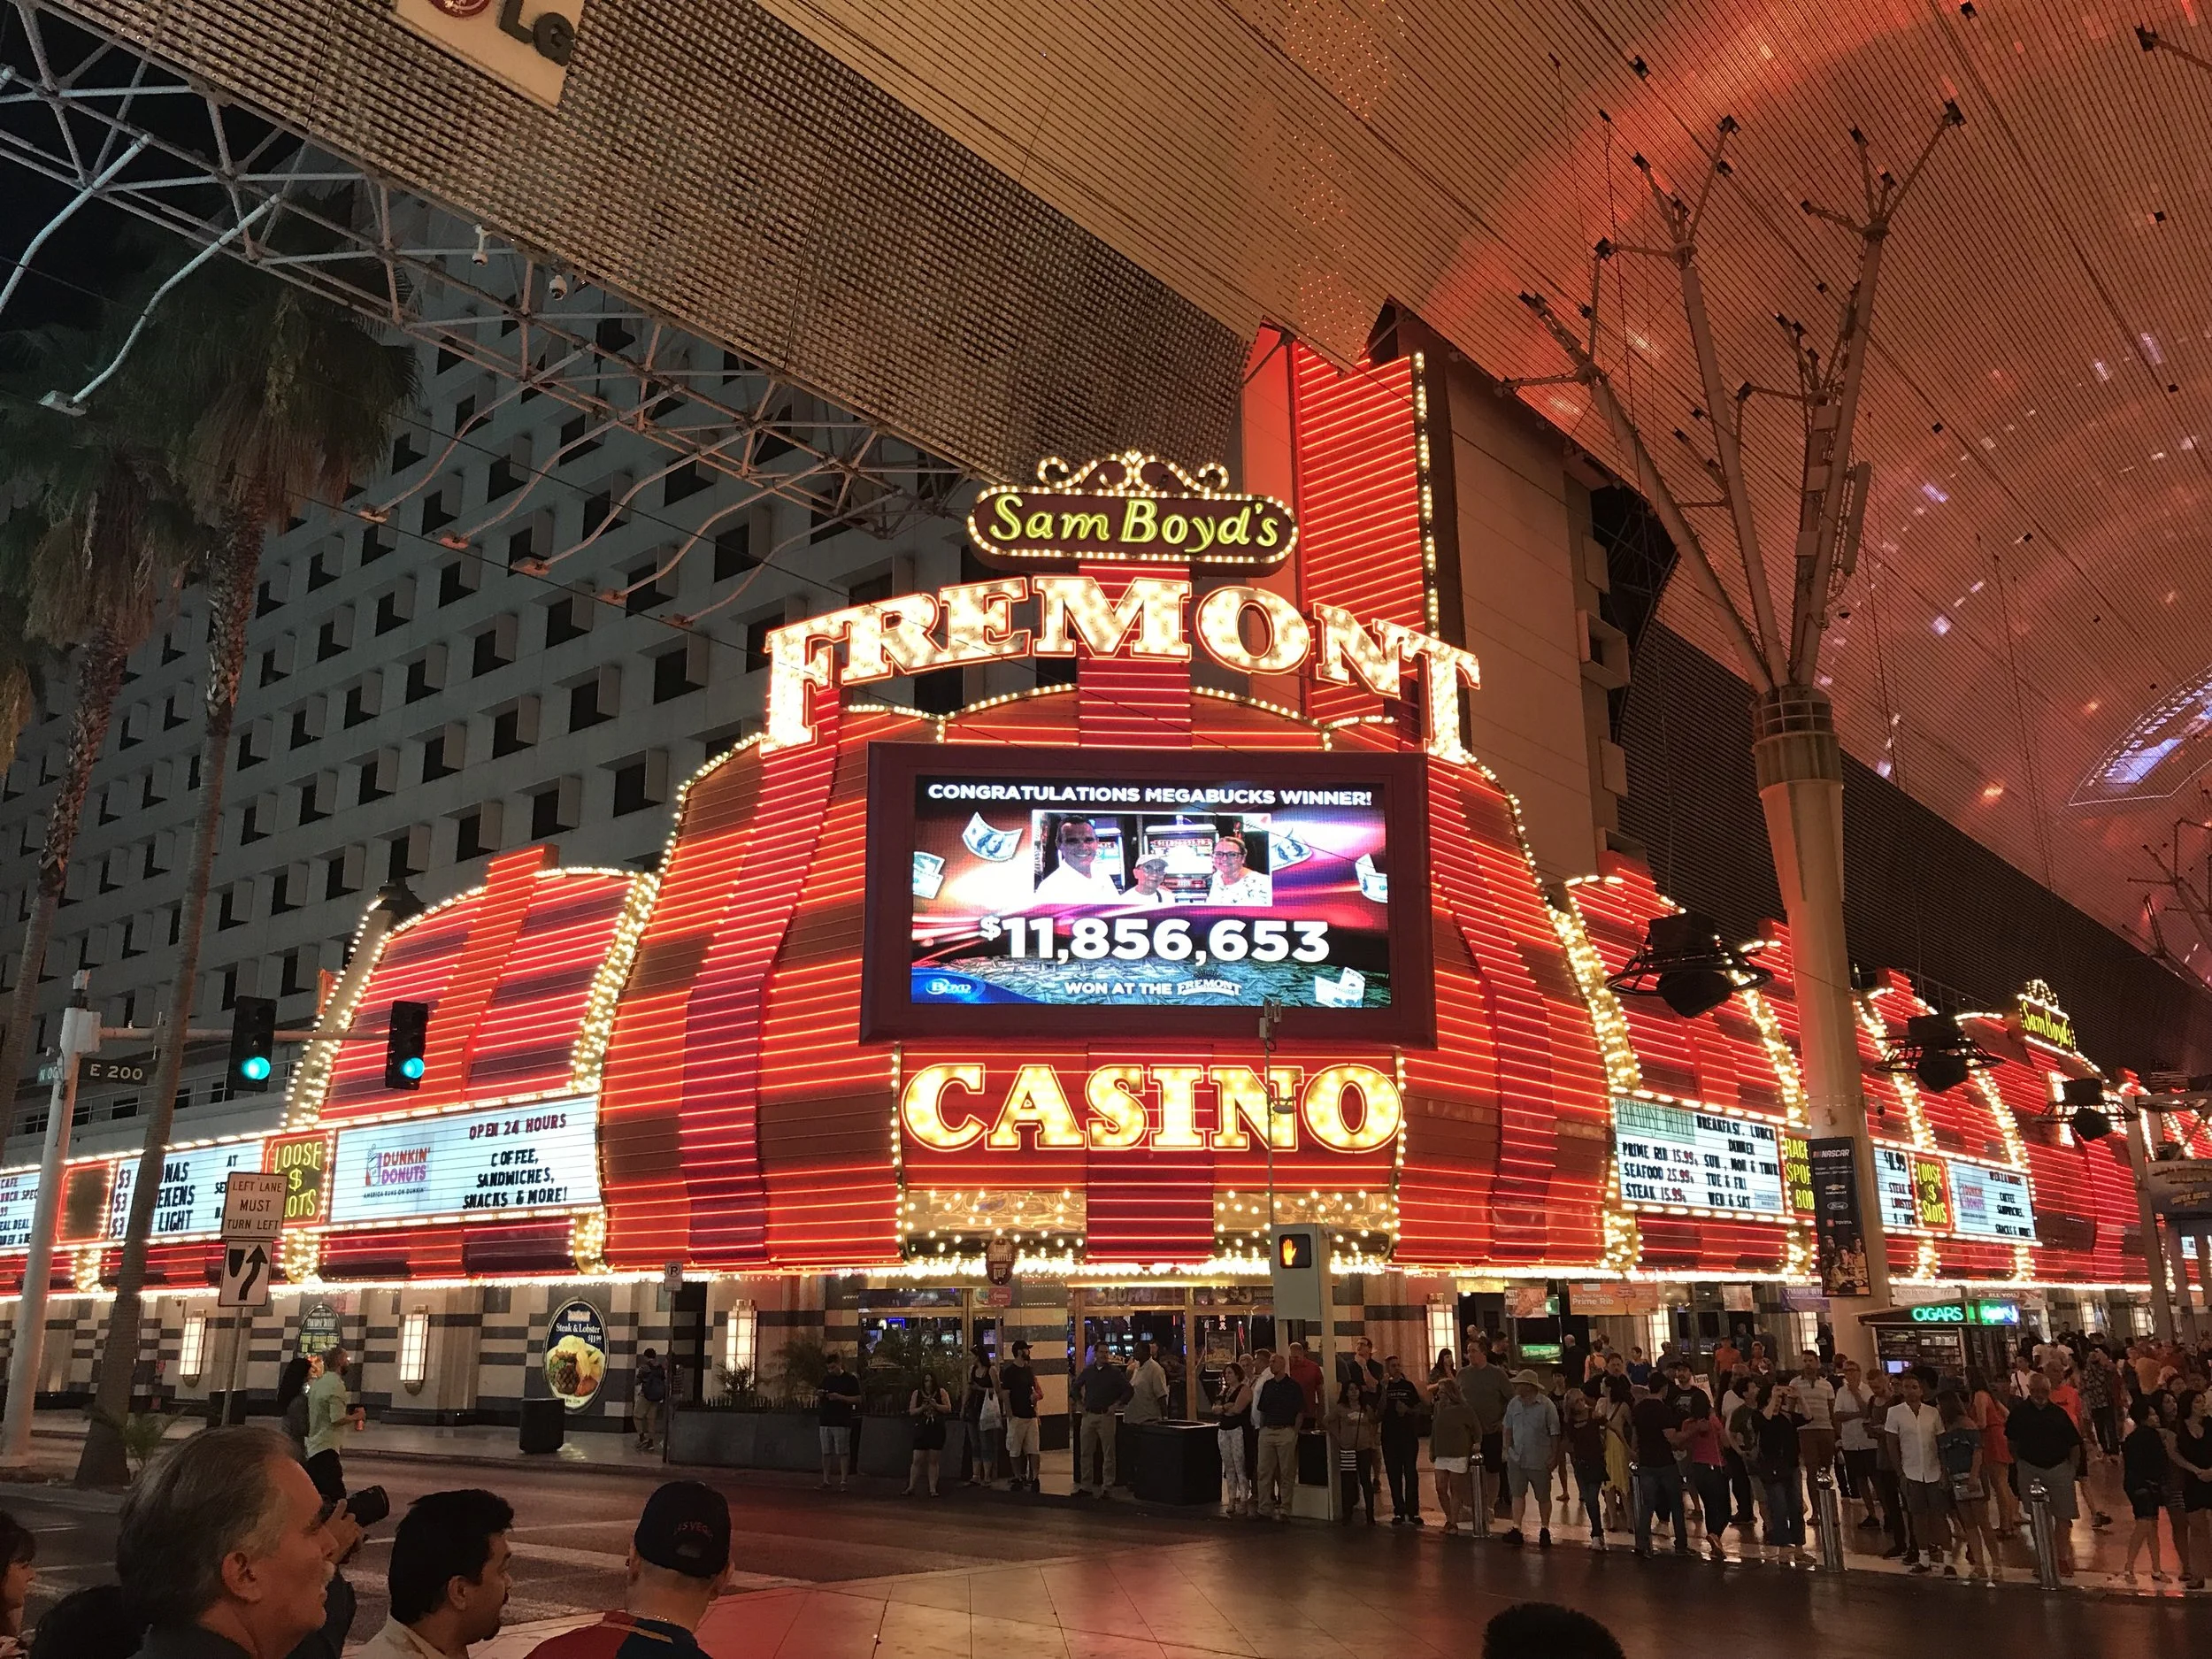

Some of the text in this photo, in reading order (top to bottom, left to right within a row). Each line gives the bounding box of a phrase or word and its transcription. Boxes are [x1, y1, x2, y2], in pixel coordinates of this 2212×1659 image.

[989, 494, 1279, 554] Sam Boyd's
[759, 575, 1482, 764] FREMONT
[927, 783, 1372, 807] CONGRATULATIONS MEGABUCKS WINNER!
[979, 917, 1330, 966] $11,856,653
[1064, 979, 1242, 996] WON AT THE FREMONT
[2023, 1001, 2047, 1035] Sam
[90, 1064, 142, 1080] E 200
[902, 1063, 1403, 1154] CASINO
[469, 1113, 567, 1140] OPEN 24 HOURS
[1750, 1125, 1775, 1141] LUNCH
[1623, 1142, 1649, 1160] PRIME
[1654, 1146, 1668, 1161] RIB
[1728, 1139, 1755, 1155] DINNER
[227, 1155, 238, 1167] AT
[275, 1141, 323, 1173] LOOSE
[381, 1147, 431, 1167] DUNKIN'
[118, 1169, 131, 1189] $3
[381, 1164, 426, 1185] DONUTS
[1624, 1162, 1663, 1180] SEAFOOD
[1917, 1163, 1943, 1189] LOOSE
[233, 1181, 282, 1192] LEFT LANE
[1706, 1172, 1722, 1187] TUE
[1734, 1177, 1747, 1191] FRI
[22, 1189, 38, 1200] SPEC
[463, 1186, 568, 1210] SNACKS & MORE!
[1625, 1182, 1656, 1201] STEAK
[1708, 1192, 1724, 1206] WED
[1737, 1195, 1751, 1210] SAT
[1796, 1189, 1815, 1210] BOO
[114, 1192, 127, 1213] $3
[240, 1199, 271, 1212] MUST
[157, 1210, 193, 1232] LIGHT
[1923, 1201, 1947, 1224] SLOTS
[0, 1220, 10, 1231] EAL
[110, 1217, 125, 1238] $3
[227, 1218, 279, 1230] TURN LEFT
[1107, 1287, 1158, 1303] BUFFET
[1912, 1306, 1963, 1322] CIGARS
[556, 1323, 600, 1333] Steak & Lobster
